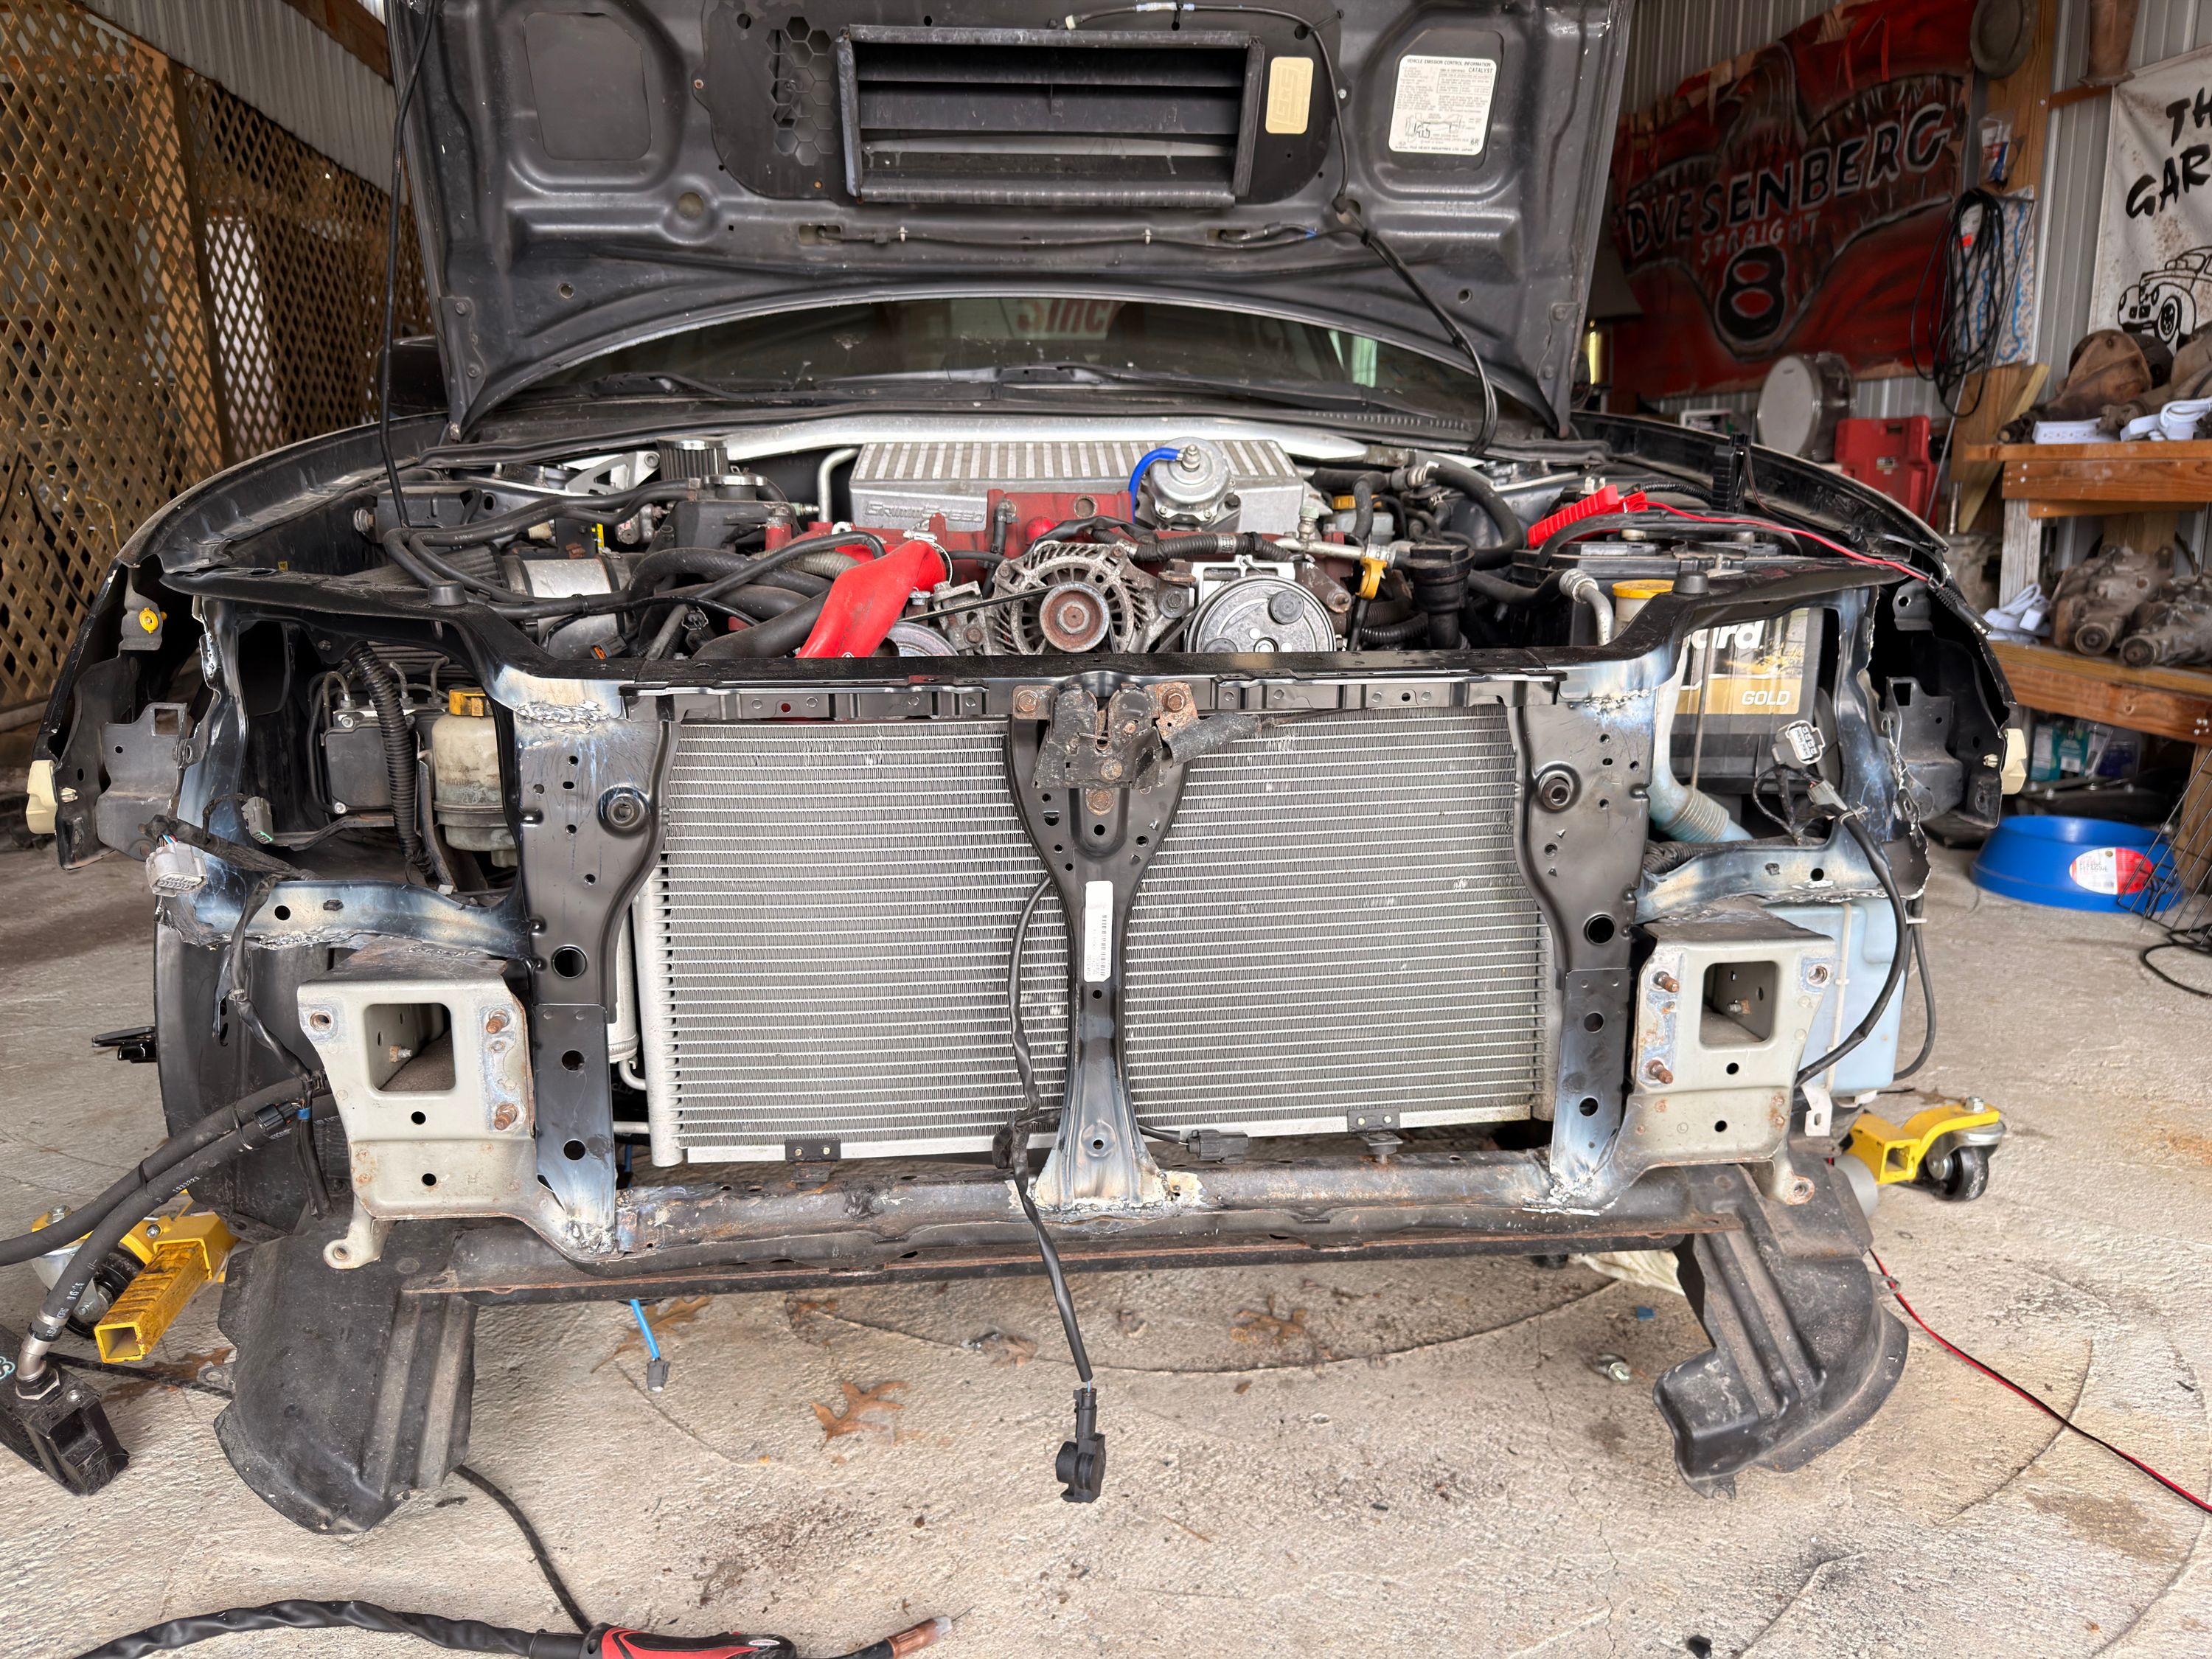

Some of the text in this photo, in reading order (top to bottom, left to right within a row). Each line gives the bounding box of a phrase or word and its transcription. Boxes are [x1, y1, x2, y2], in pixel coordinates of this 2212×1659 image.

[1700, 212, 1820, 265] STRAIGHT
[1715, 246, 1787, 345] 8
[1741, 690, 1791, 706] GOLD
